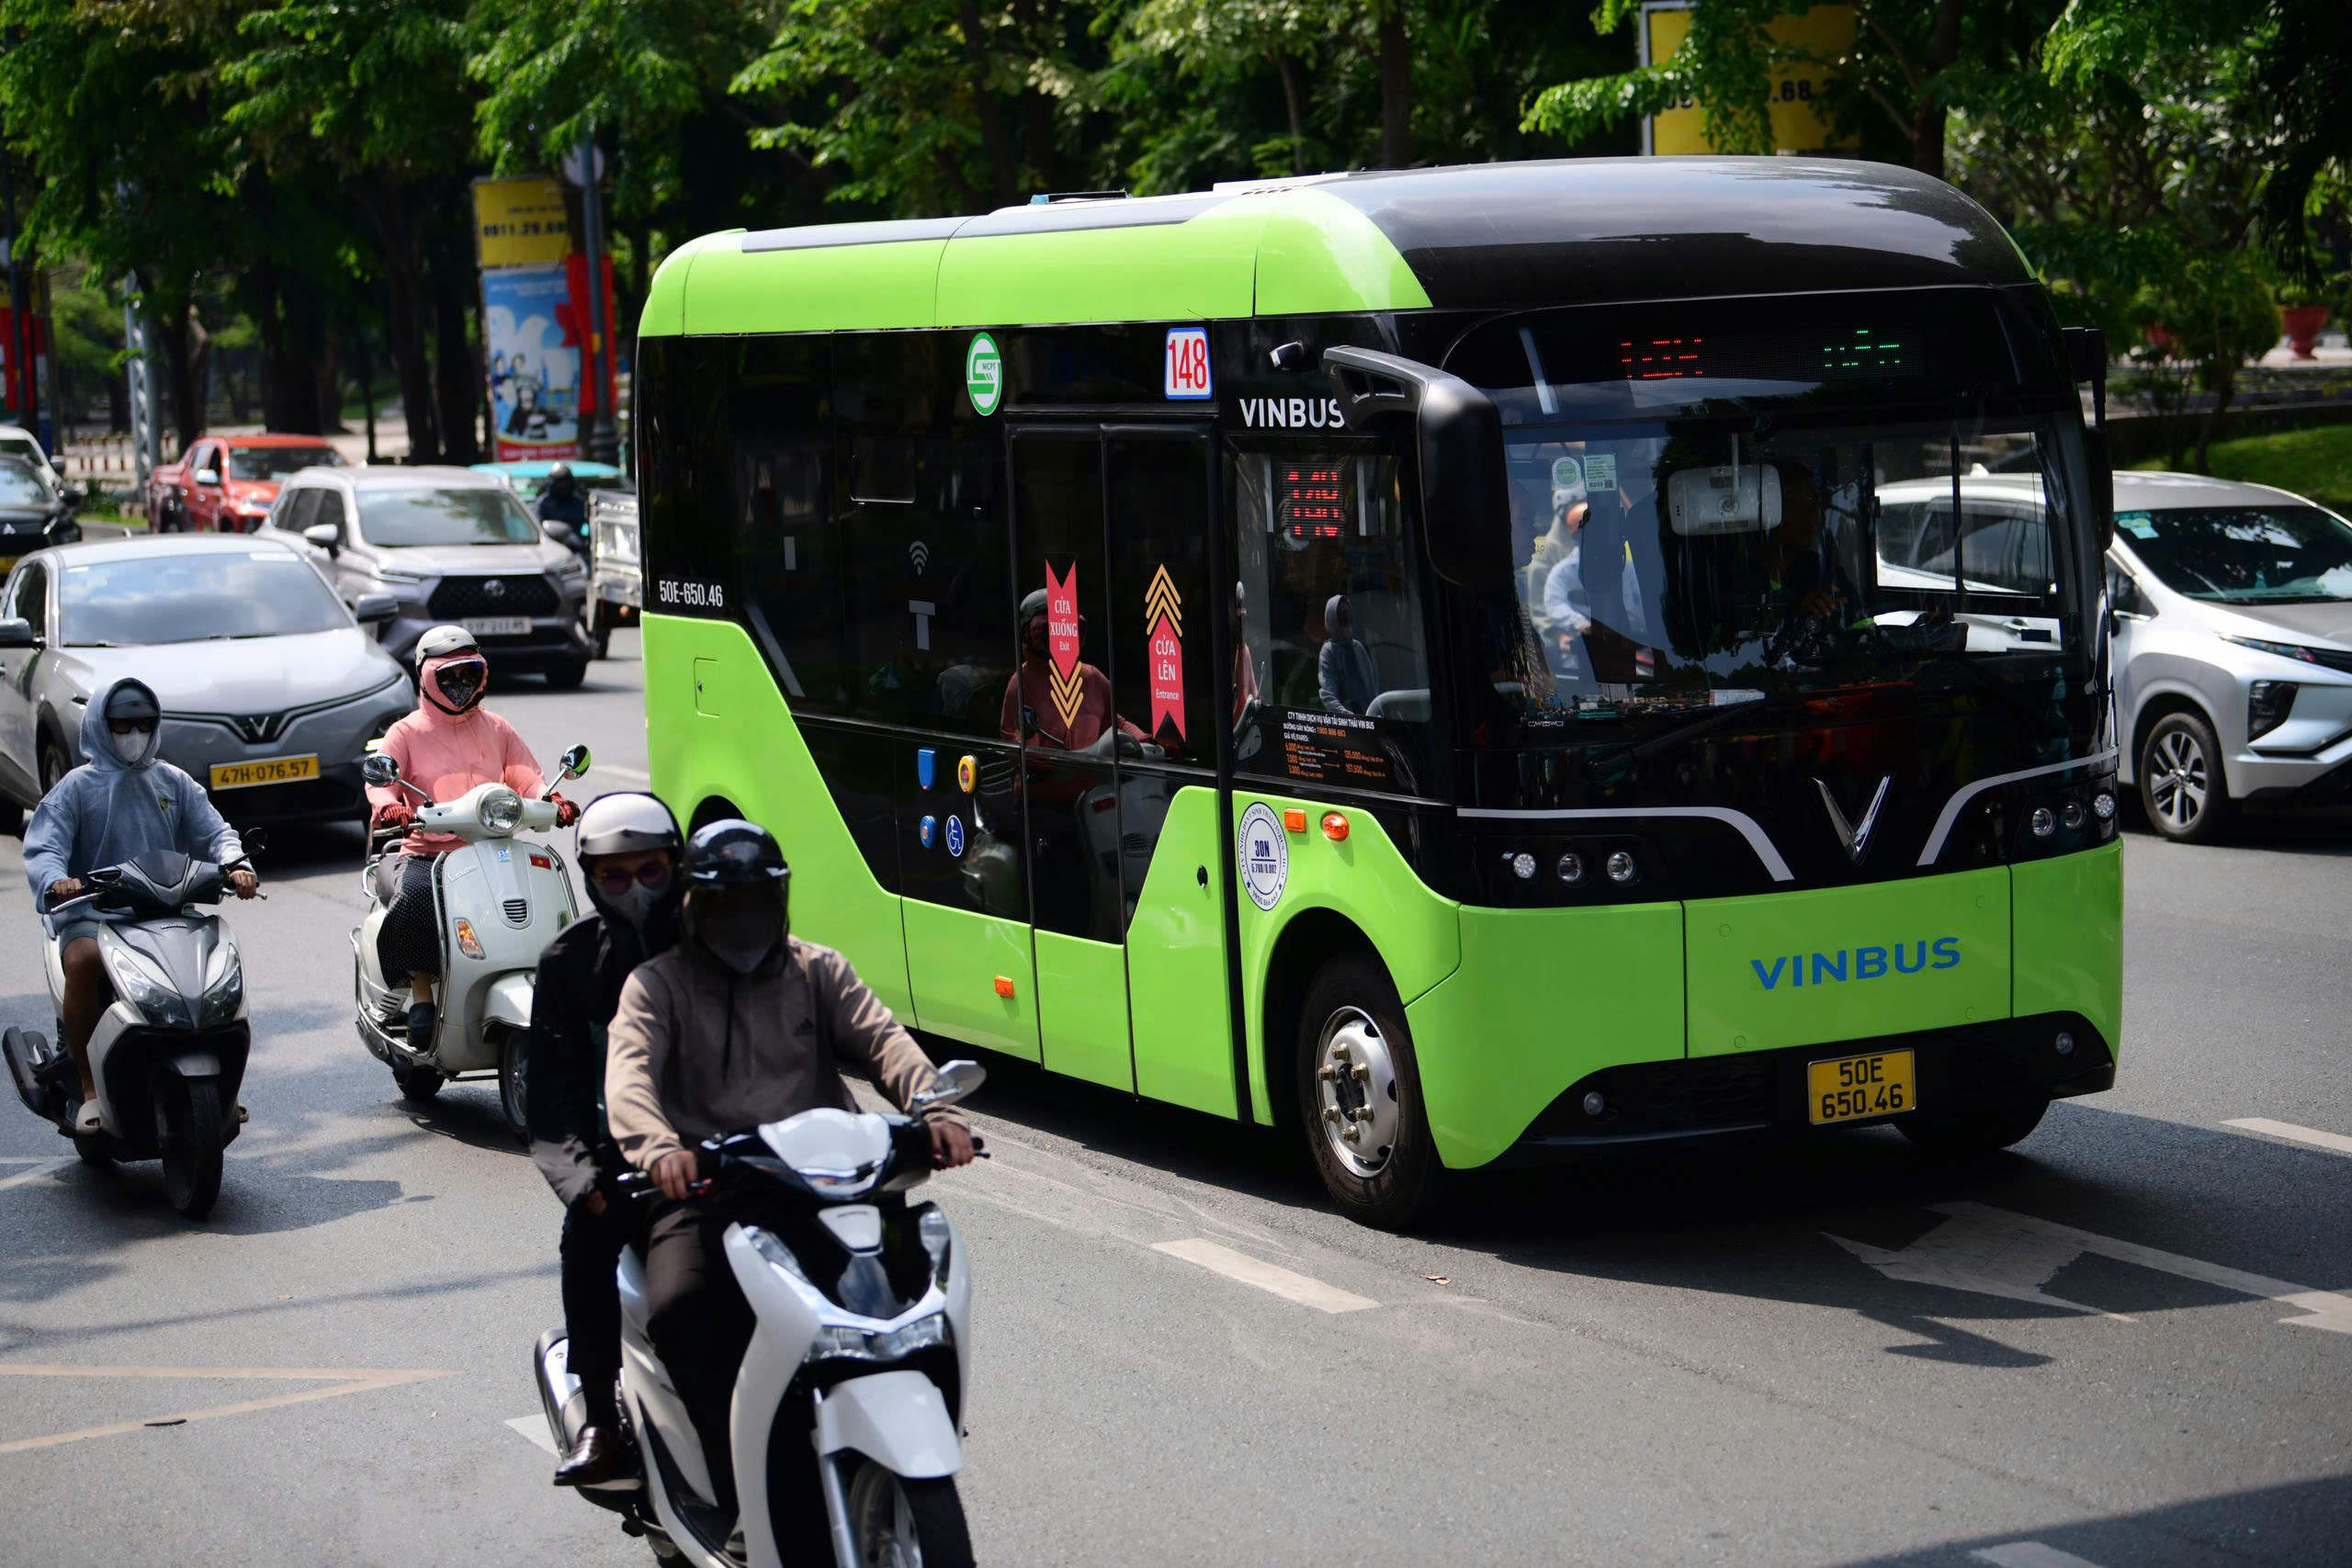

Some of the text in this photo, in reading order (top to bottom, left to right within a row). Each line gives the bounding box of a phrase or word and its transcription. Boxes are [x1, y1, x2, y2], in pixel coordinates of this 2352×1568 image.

[1168, 338, 1206, 389] 148
[1239, 398, 1345, 428] VINBUS
[660, 580, 723, 607] 50E-650.46
[1055, 596, 1071, 615] CỬA
[1050, 617, 1078, 637] XUỐNG
[1059, 641, 1070, 651] Exit
[1155, 633, 1176, 656] CỬA
[1158, 659, 1176, 681] LÊN
[1156, 688, 1180, 701] Entrance
[1254, 840, 1271, 858] 30N
[1749, 936, 1962, 990] VINBUS
[1838, 1056, 1884, 1087] 50E
[1822, 1083, 1904, 1119] 650.46
